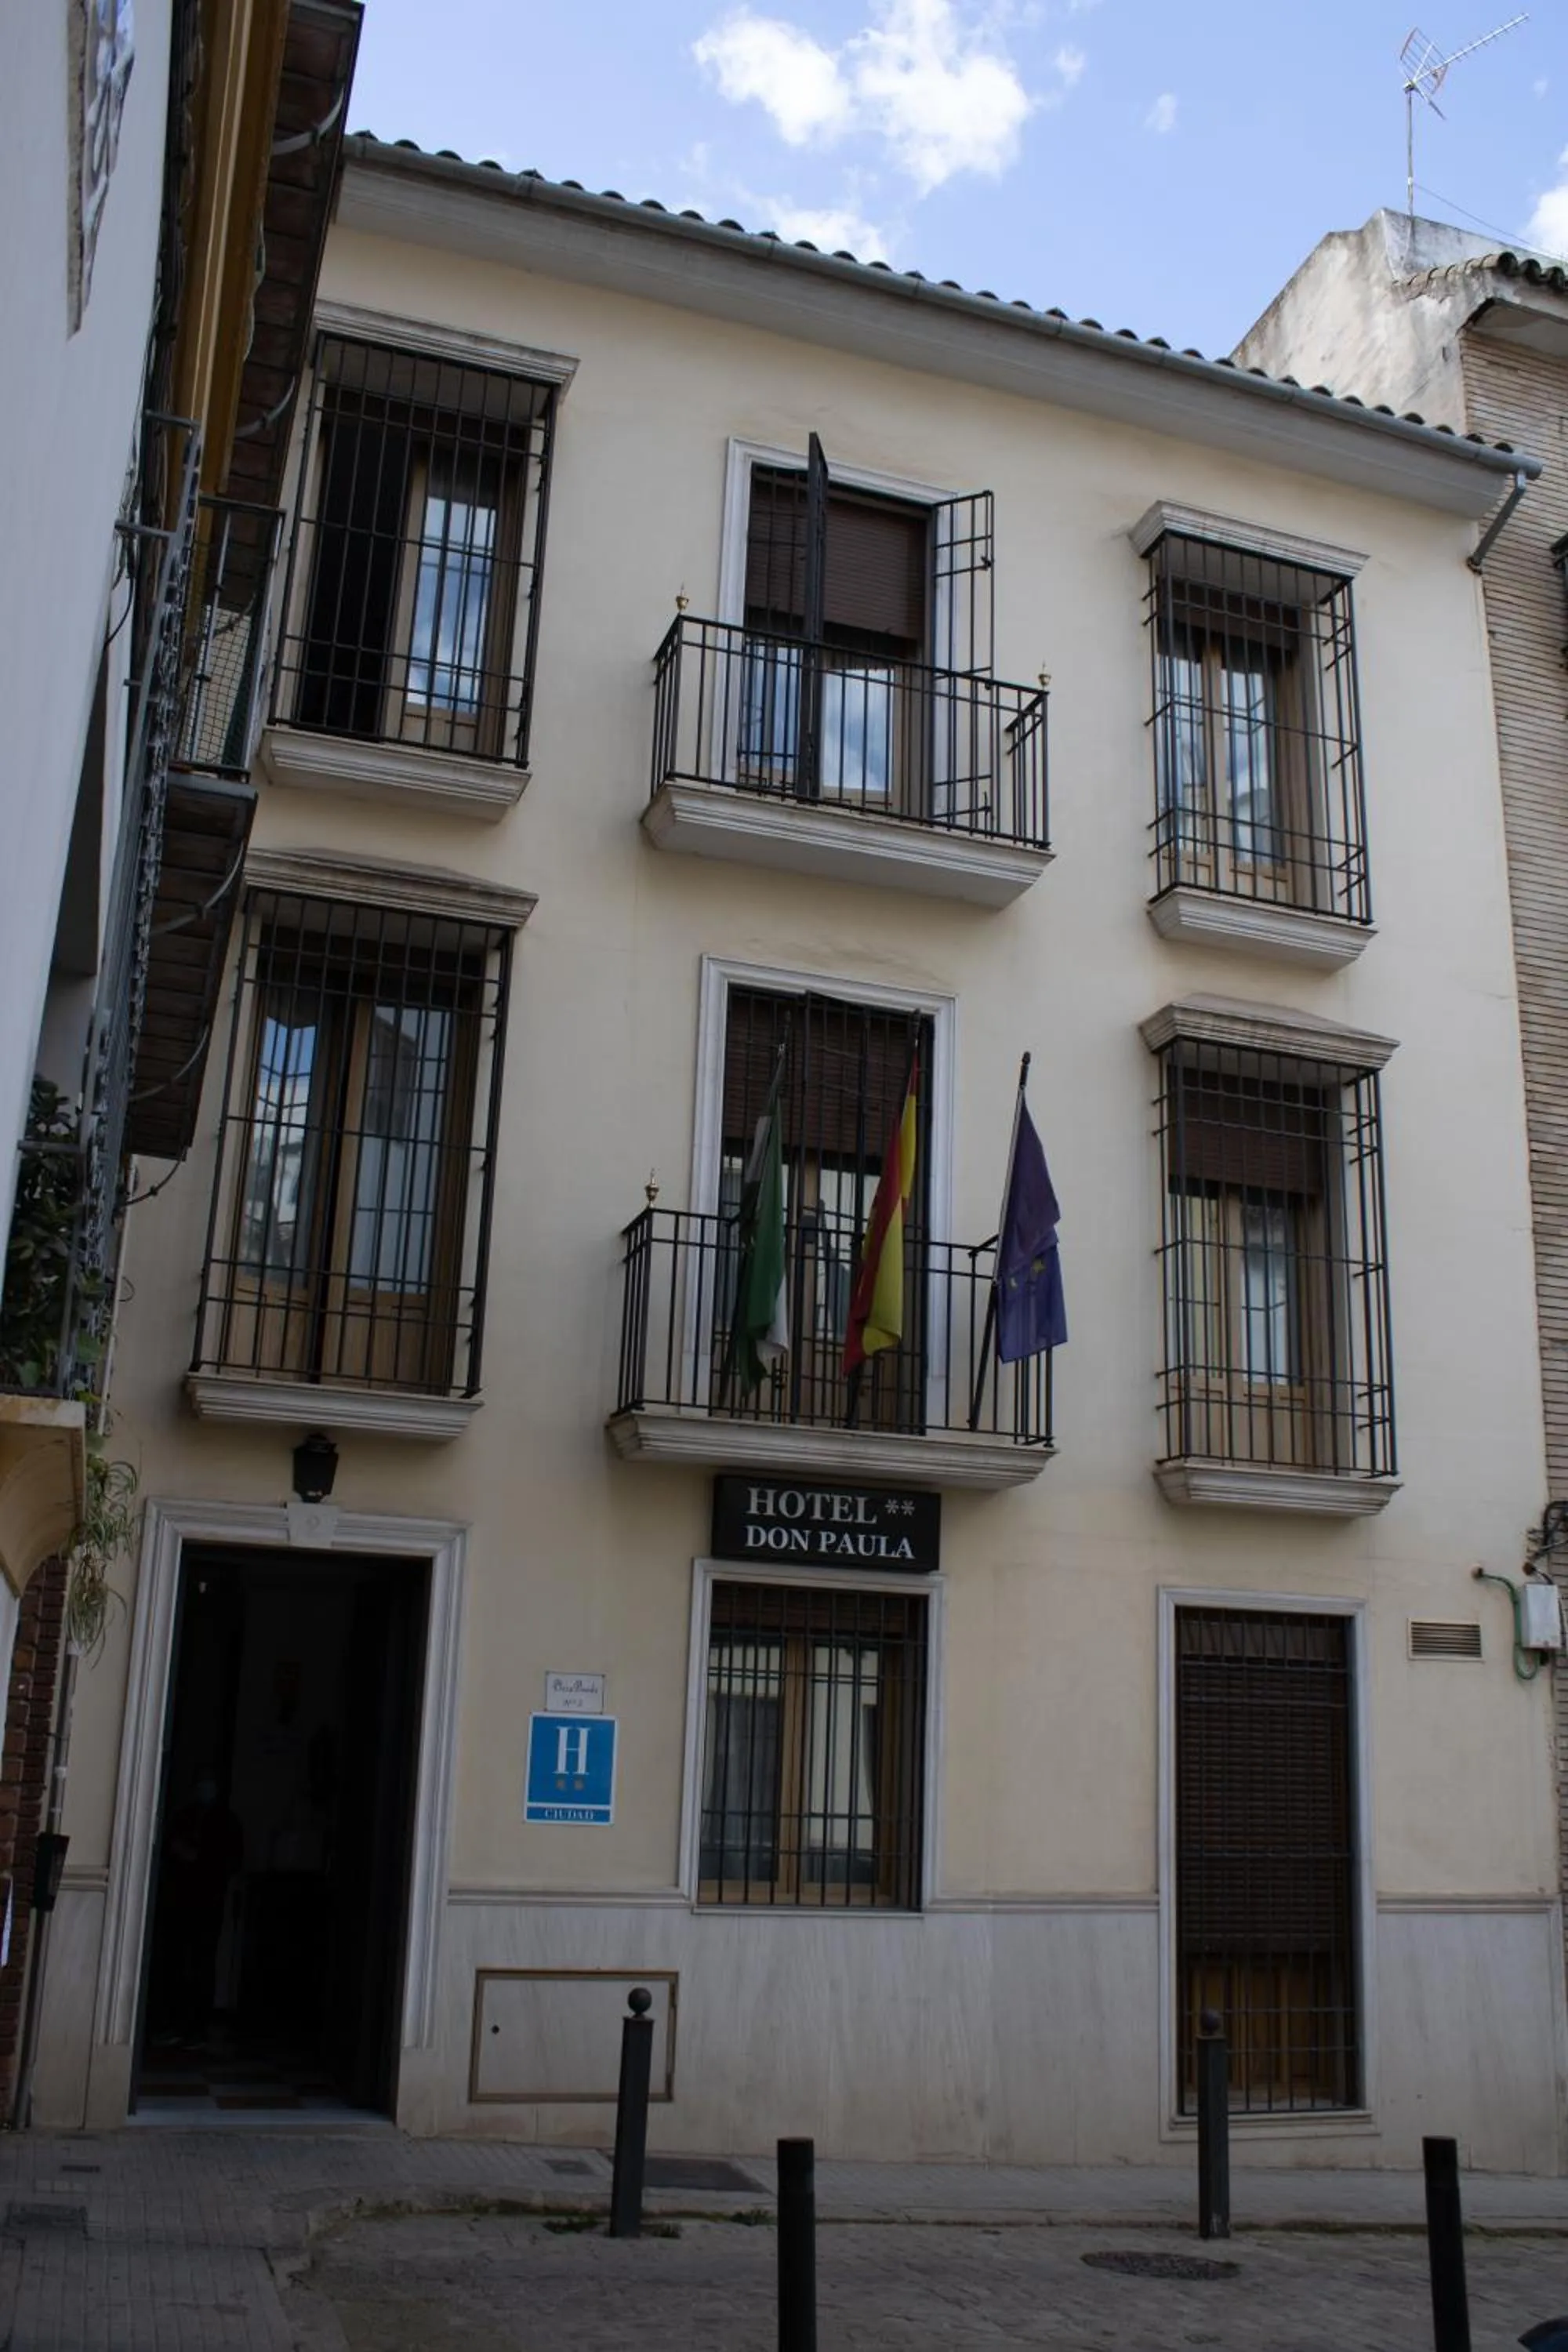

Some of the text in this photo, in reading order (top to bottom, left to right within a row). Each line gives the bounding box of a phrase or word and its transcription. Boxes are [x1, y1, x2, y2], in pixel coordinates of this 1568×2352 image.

[746, 1487, 877, 1524] HOTEL
[744, 1525, 916, 1559] DON PAULA
[552, 1726, 591, 1775] H
[544, 1808, 595, 1820] CIUDAD
